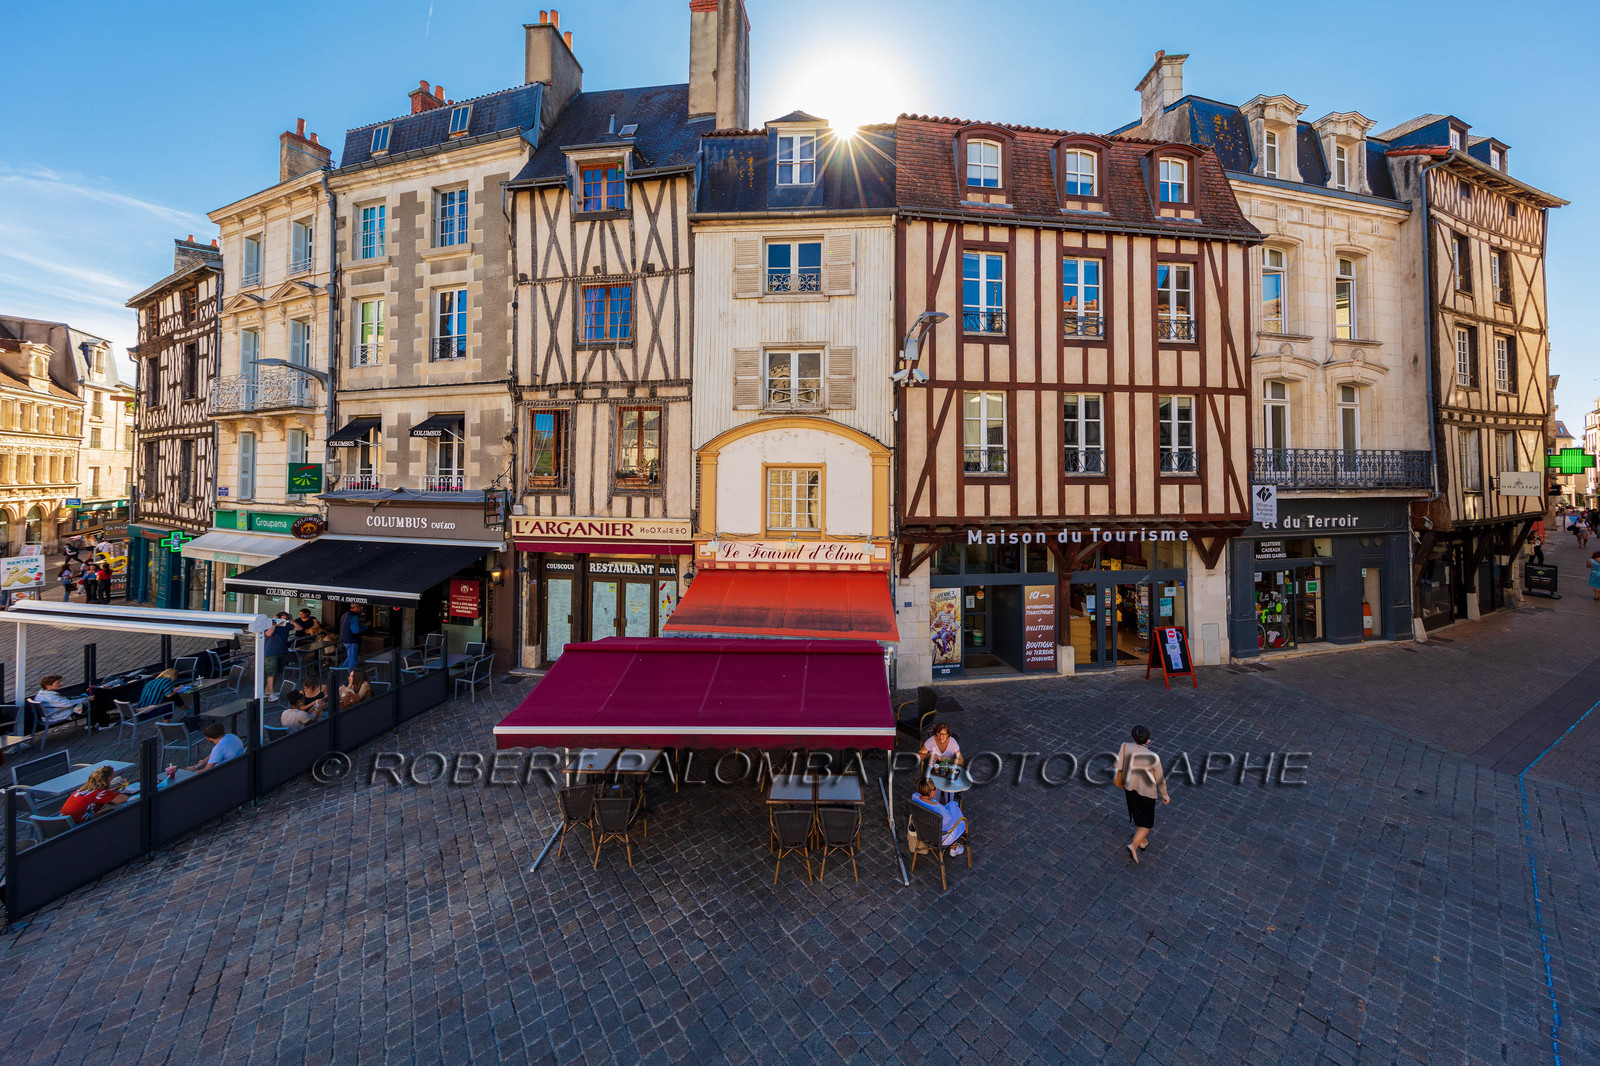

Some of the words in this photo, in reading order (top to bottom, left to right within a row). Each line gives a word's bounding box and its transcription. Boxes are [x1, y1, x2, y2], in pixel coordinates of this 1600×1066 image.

[256, 517, 287, 528] Groupama
[294, 516, 323, 528] COLUMBUS
[366, 516, 428, 529] COLUMBUS
[1283, 516, 1300, 528] du
[1306, 514, 1358, 528] Terroir
[515, 520, 634, 537] L'ARGANIER
[967, 530, 1046, 545] Maison
[1057, 528, 1082, 544] du
[1090, 528, 1189, 542] Tourisme
[722, 543, 740, 559] Le
[748, 543, 805, 560] Fournil
[808, 544, 864, 561] d'Elina
[589, 562, 654, 574] RESTAURANT
[266, 588, 298, 598] COLUMBUS
[1030, 591, 1040, 600] ICI
[1026, 641, 1054, 650] BOUTIQUE
